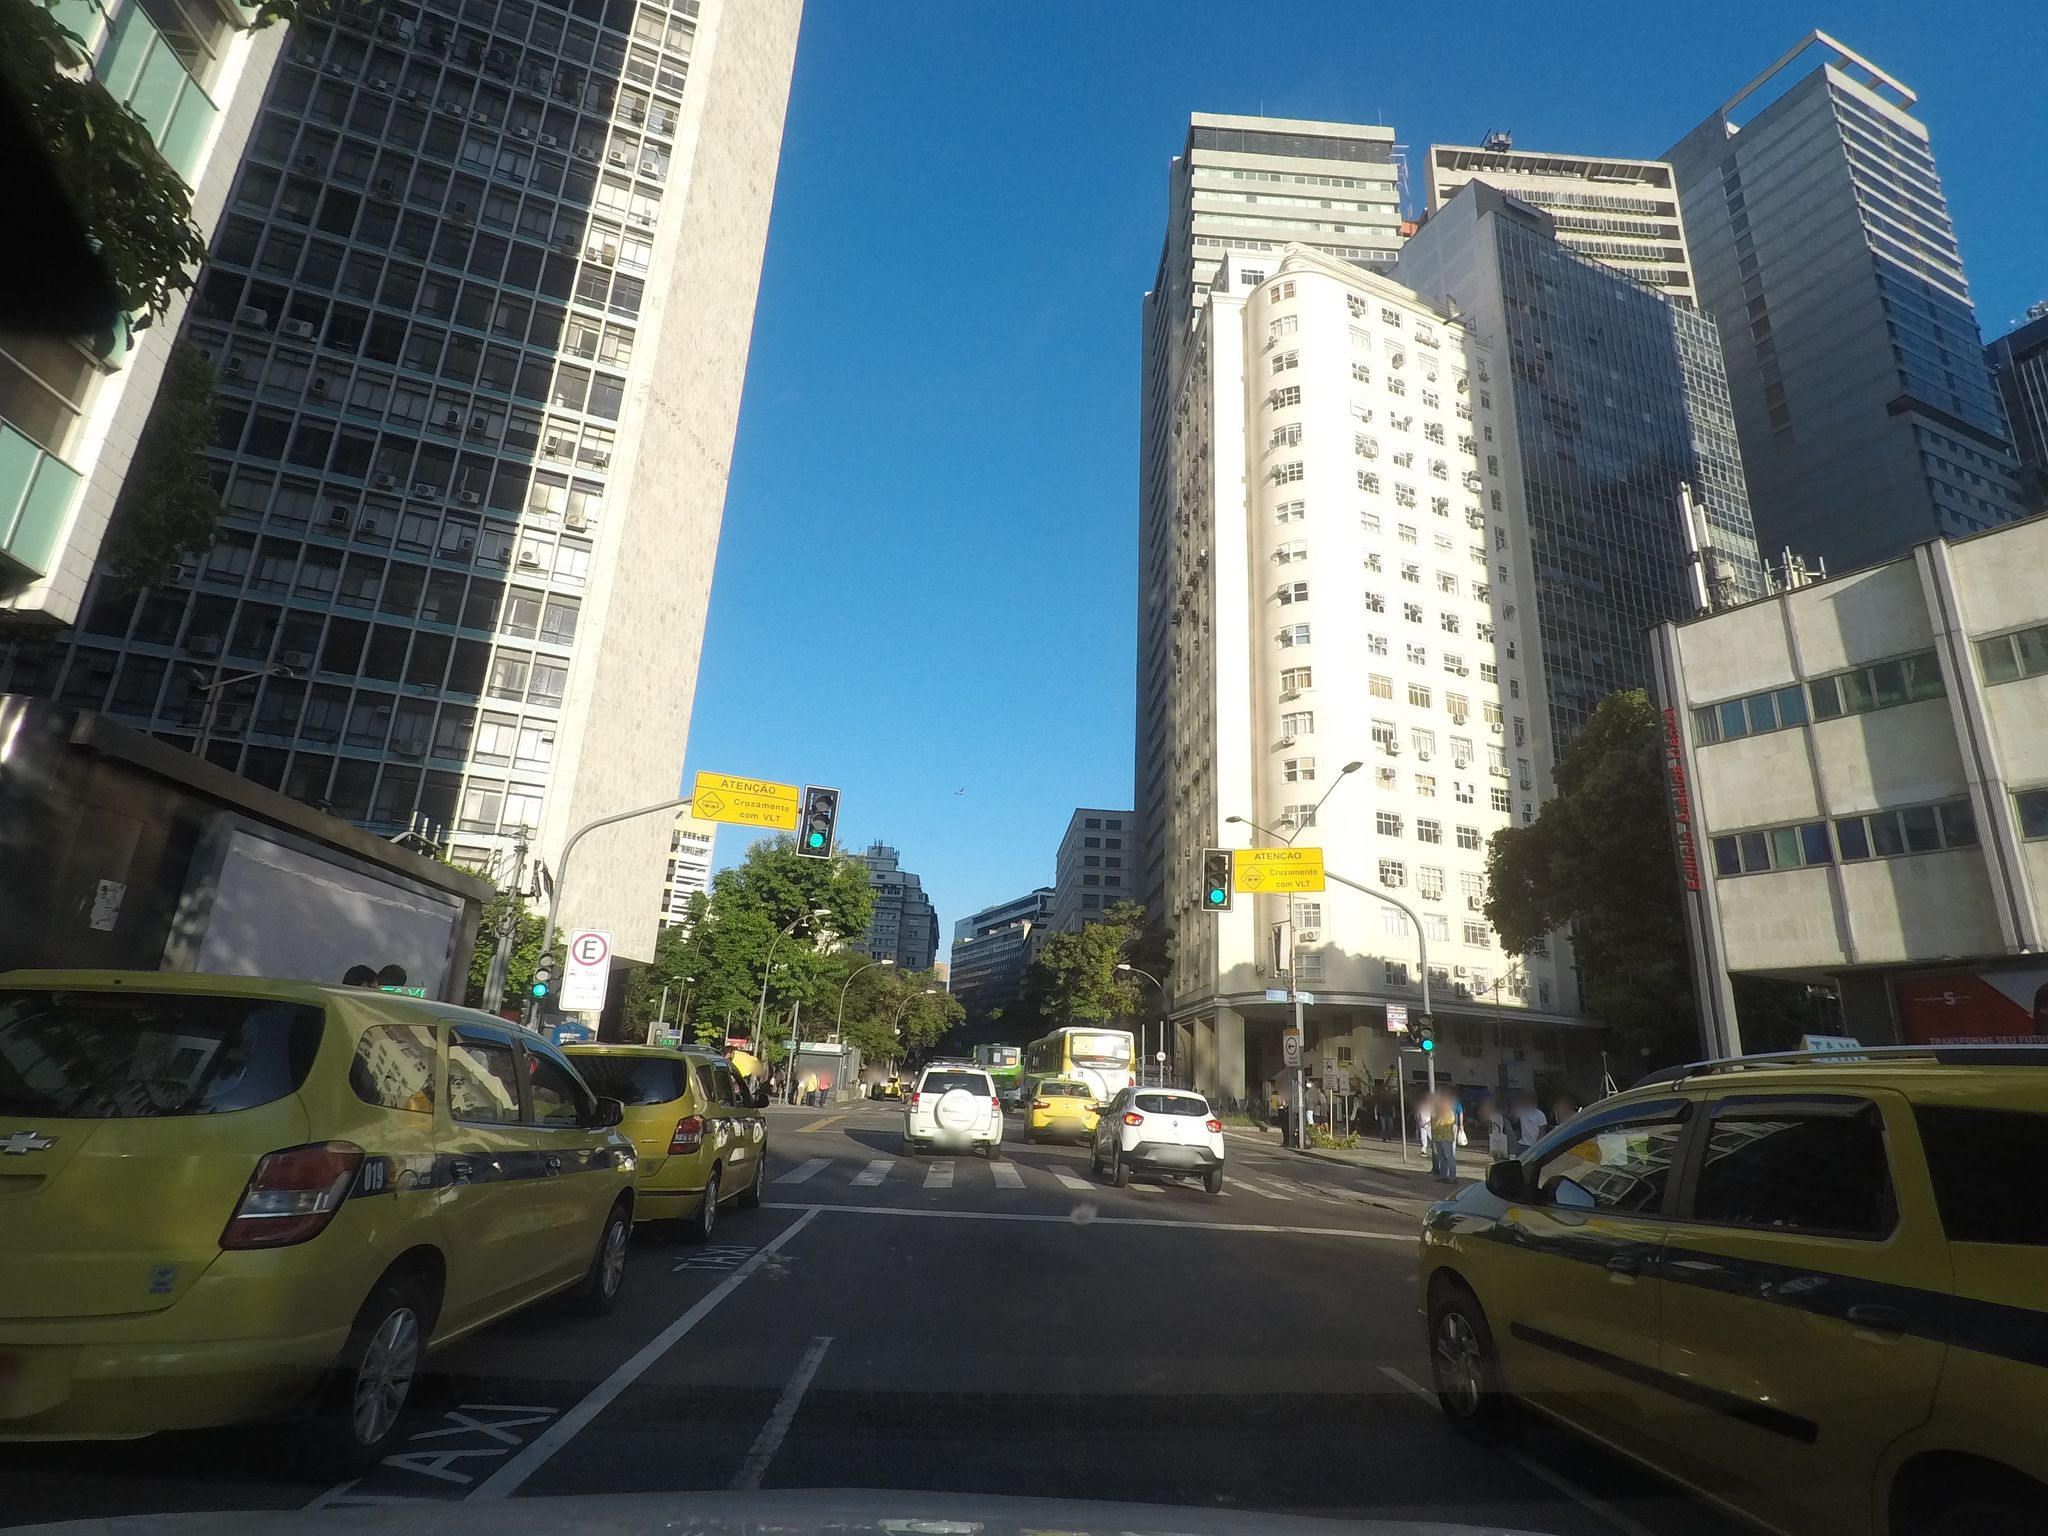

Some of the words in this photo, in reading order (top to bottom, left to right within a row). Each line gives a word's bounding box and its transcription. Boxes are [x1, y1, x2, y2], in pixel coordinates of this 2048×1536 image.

[721, 780, 776, 795] ATENÇÃO
[733, 798, 790, 812] Cruzamento
[739, 811, 759, 820] com
[763, 813, 781, 823] VLT
[1269, 868, 1318, 876] Cruzamento
[1275, 881, 1293, 889] com
[1295, 880, 1311, 888] VLT
[582, 940, 597, 960] E
[659, 1038, 677, 1047] TAXI
[364, 1161, 384, 1191] 019
[671, 1245, 758, 1272] TAXI
